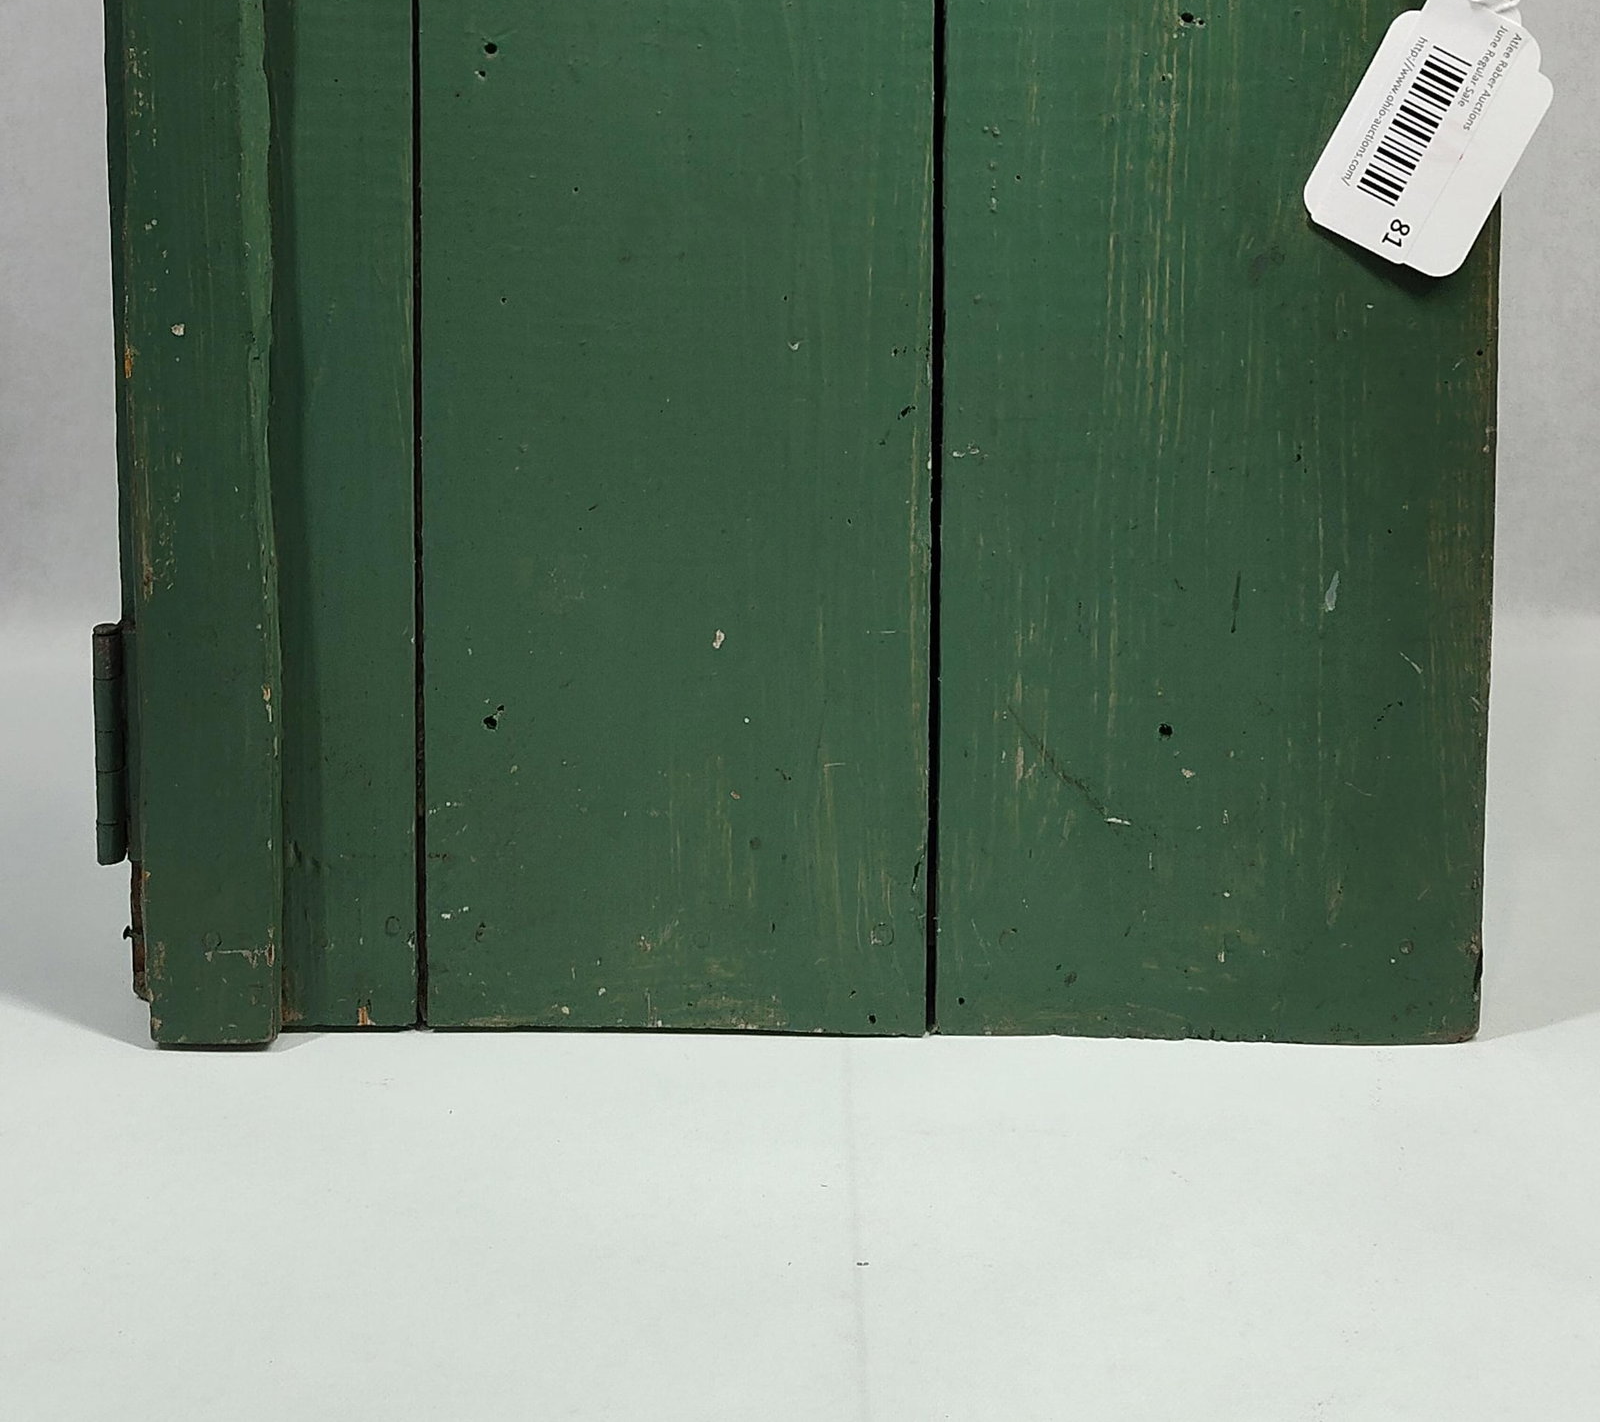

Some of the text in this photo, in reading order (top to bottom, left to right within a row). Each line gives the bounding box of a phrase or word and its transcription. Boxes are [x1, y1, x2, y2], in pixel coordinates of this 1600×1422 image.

[1341, 37, 1428, 186] http://www.ohio-auctions.com/
[1457, 25, 1508, 108] June Regular Sale
[1462, 33, 1523, 131] Atlee Raber Auctions
[1382, 218, 1411, 247] 81
